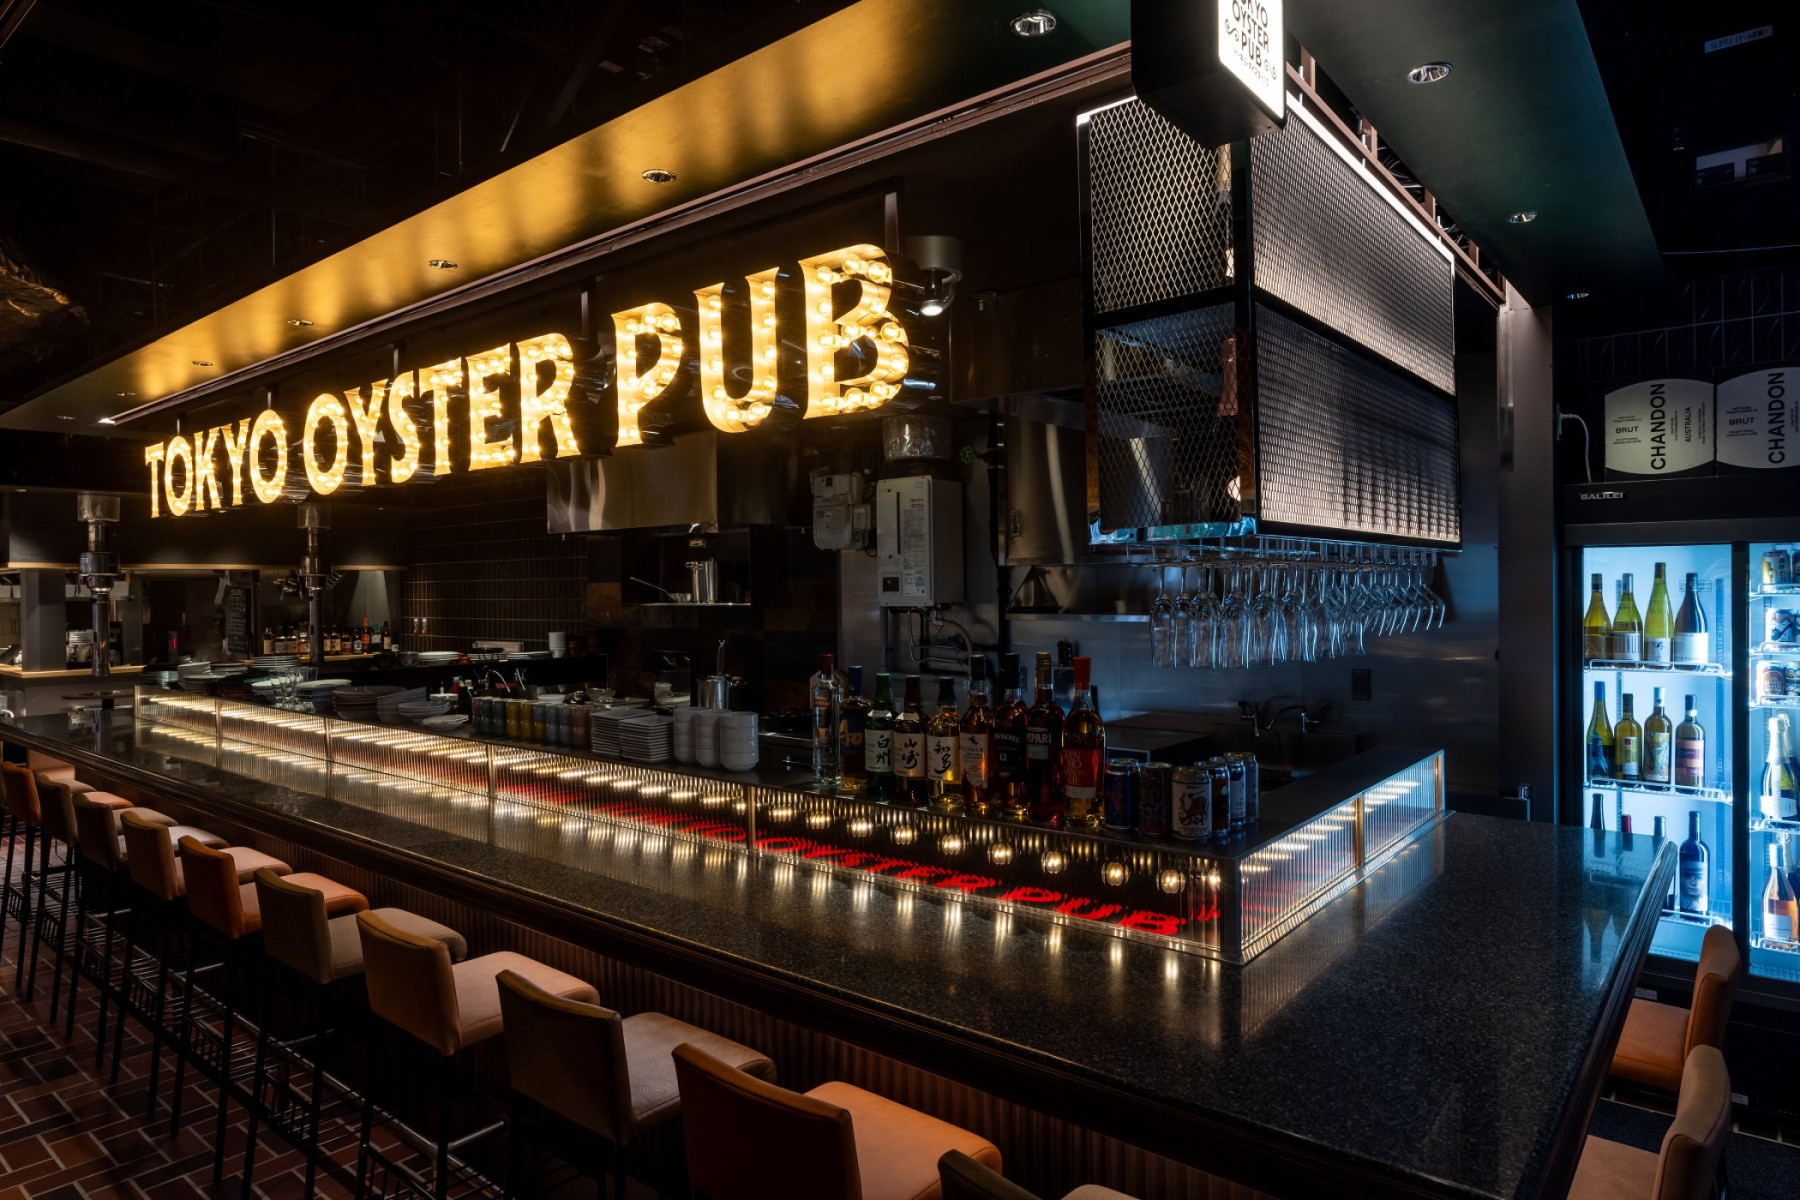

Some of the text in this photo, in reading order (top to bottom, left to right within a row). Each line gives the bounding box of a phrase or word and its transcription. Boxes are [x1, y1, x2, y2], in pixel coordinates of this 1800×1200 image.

[1232, 0, 1269, 53] OYSTER
[1241, 31, 1262, 68] PUB
[145, 243, 909, 518] TOKYO OYSTER PUB
[1616, 426, 1639, 434] BRUT
[1650, 383, 1666, 470] CHANDON
[1684, 407, 1692, 443] AUSTRALIA
[1729, 416, 1756, 426] BRUT
[1768, 372, 1785, 464] CHANDON
[875, 734, 891, 767] 白州
[901, 738, 920, 769] 山崎
[933, 740, 951, 775] 知多
[999, 752, 1008, 762] 12
